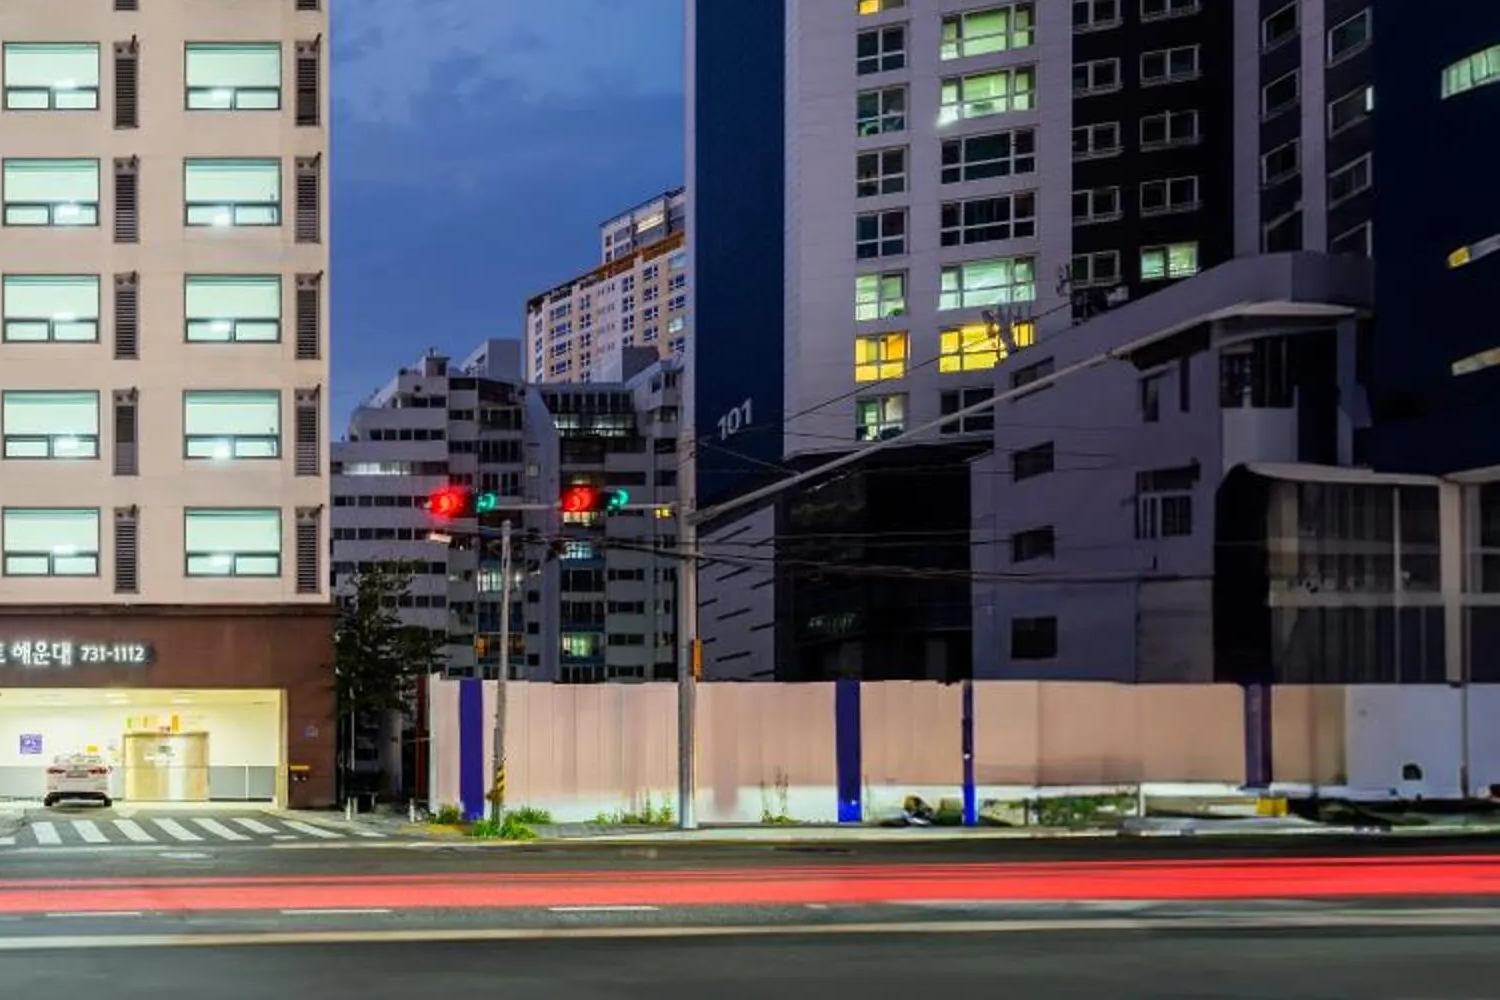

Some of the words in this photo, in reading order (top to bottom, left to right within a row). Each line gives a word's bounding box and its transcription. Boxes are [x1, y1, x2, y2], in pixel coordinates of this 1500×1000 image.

[718, 398, 752, 440] 101
[12, 641, 72, 666] 해운대
[80, 645, 145, 662] 731-1112
